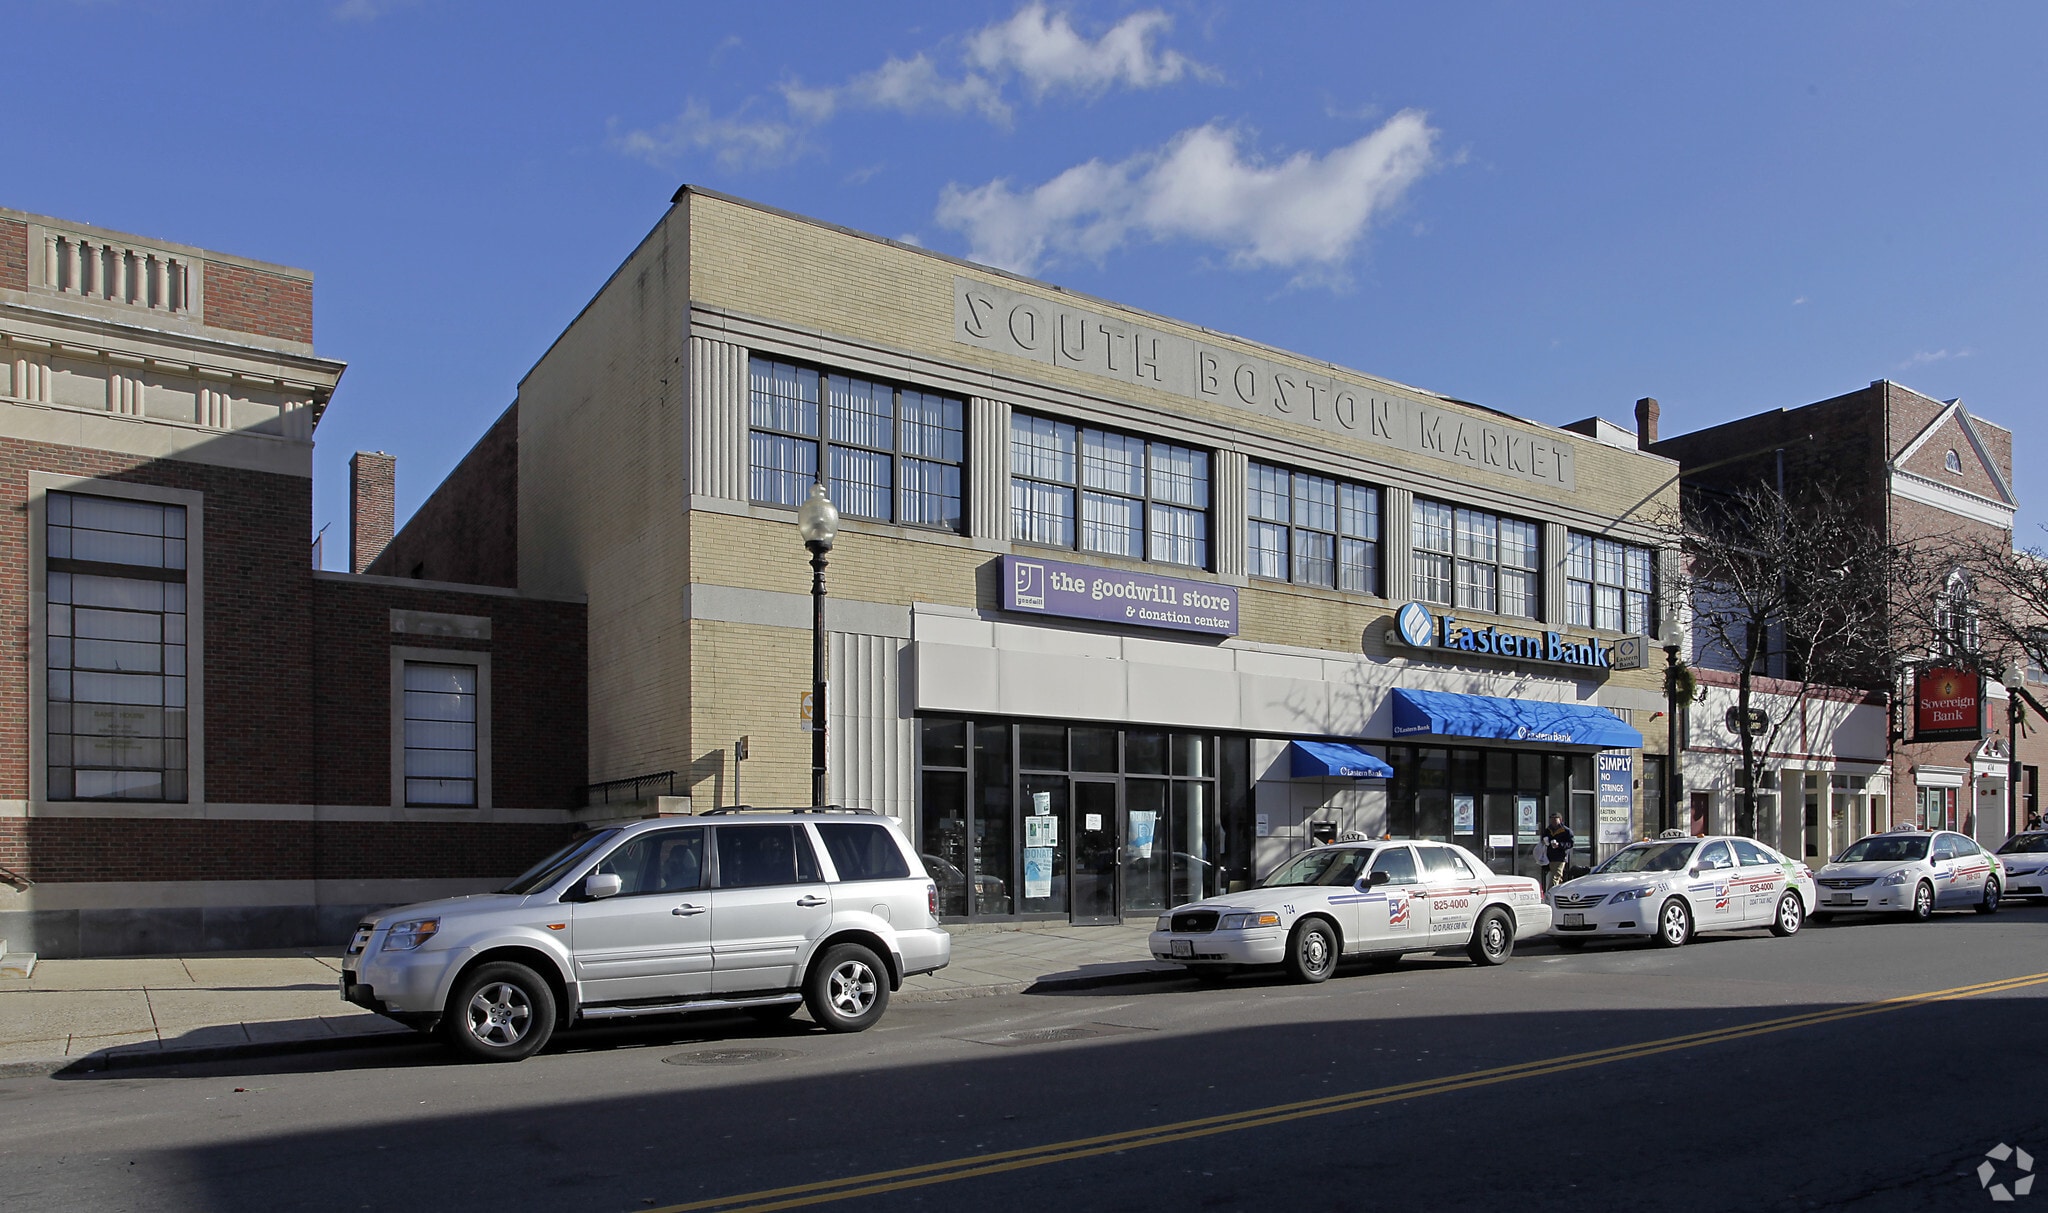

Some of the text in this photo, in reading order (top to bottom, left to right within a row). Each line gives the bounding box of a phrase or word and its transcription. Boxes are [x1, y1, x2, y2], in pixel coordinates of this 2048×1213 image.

[963, 290, 1570, 484] SOUTH BOSTON MARKET
[1050, 571, 1230, 611] the goodwill store
[1018, 597, 1043, 605] goodwill
[1125, 606, 1230, 629] & donation center
[1441, 615, 1609, 669] Eastern Bank
[1616, 655, 1639, 663] Eastern
[1920, 696, 1975, 710] Sovereign
[1932, 709, 1963, 722] Bank
[1417, 724, 1431, 732] Bank
[1553, 731, 1572, 742] Bank
[1599, 757, 1631, 771] SIMPLY
[1347, 768, 1383, 777] Eastern Bank
[1600, 773, 1611, 781] NO
[1601, 784, 1624, 792] STRINGS
[1601, 795, 1628, 803] ATTACHED
[1341, 833, 1361, 842] TAXI
[1749, 883, 1774, 893] 825-4000
[1284, 904, 1296, 915] 734
[1433, 898, 1469, 910] 825-4000
